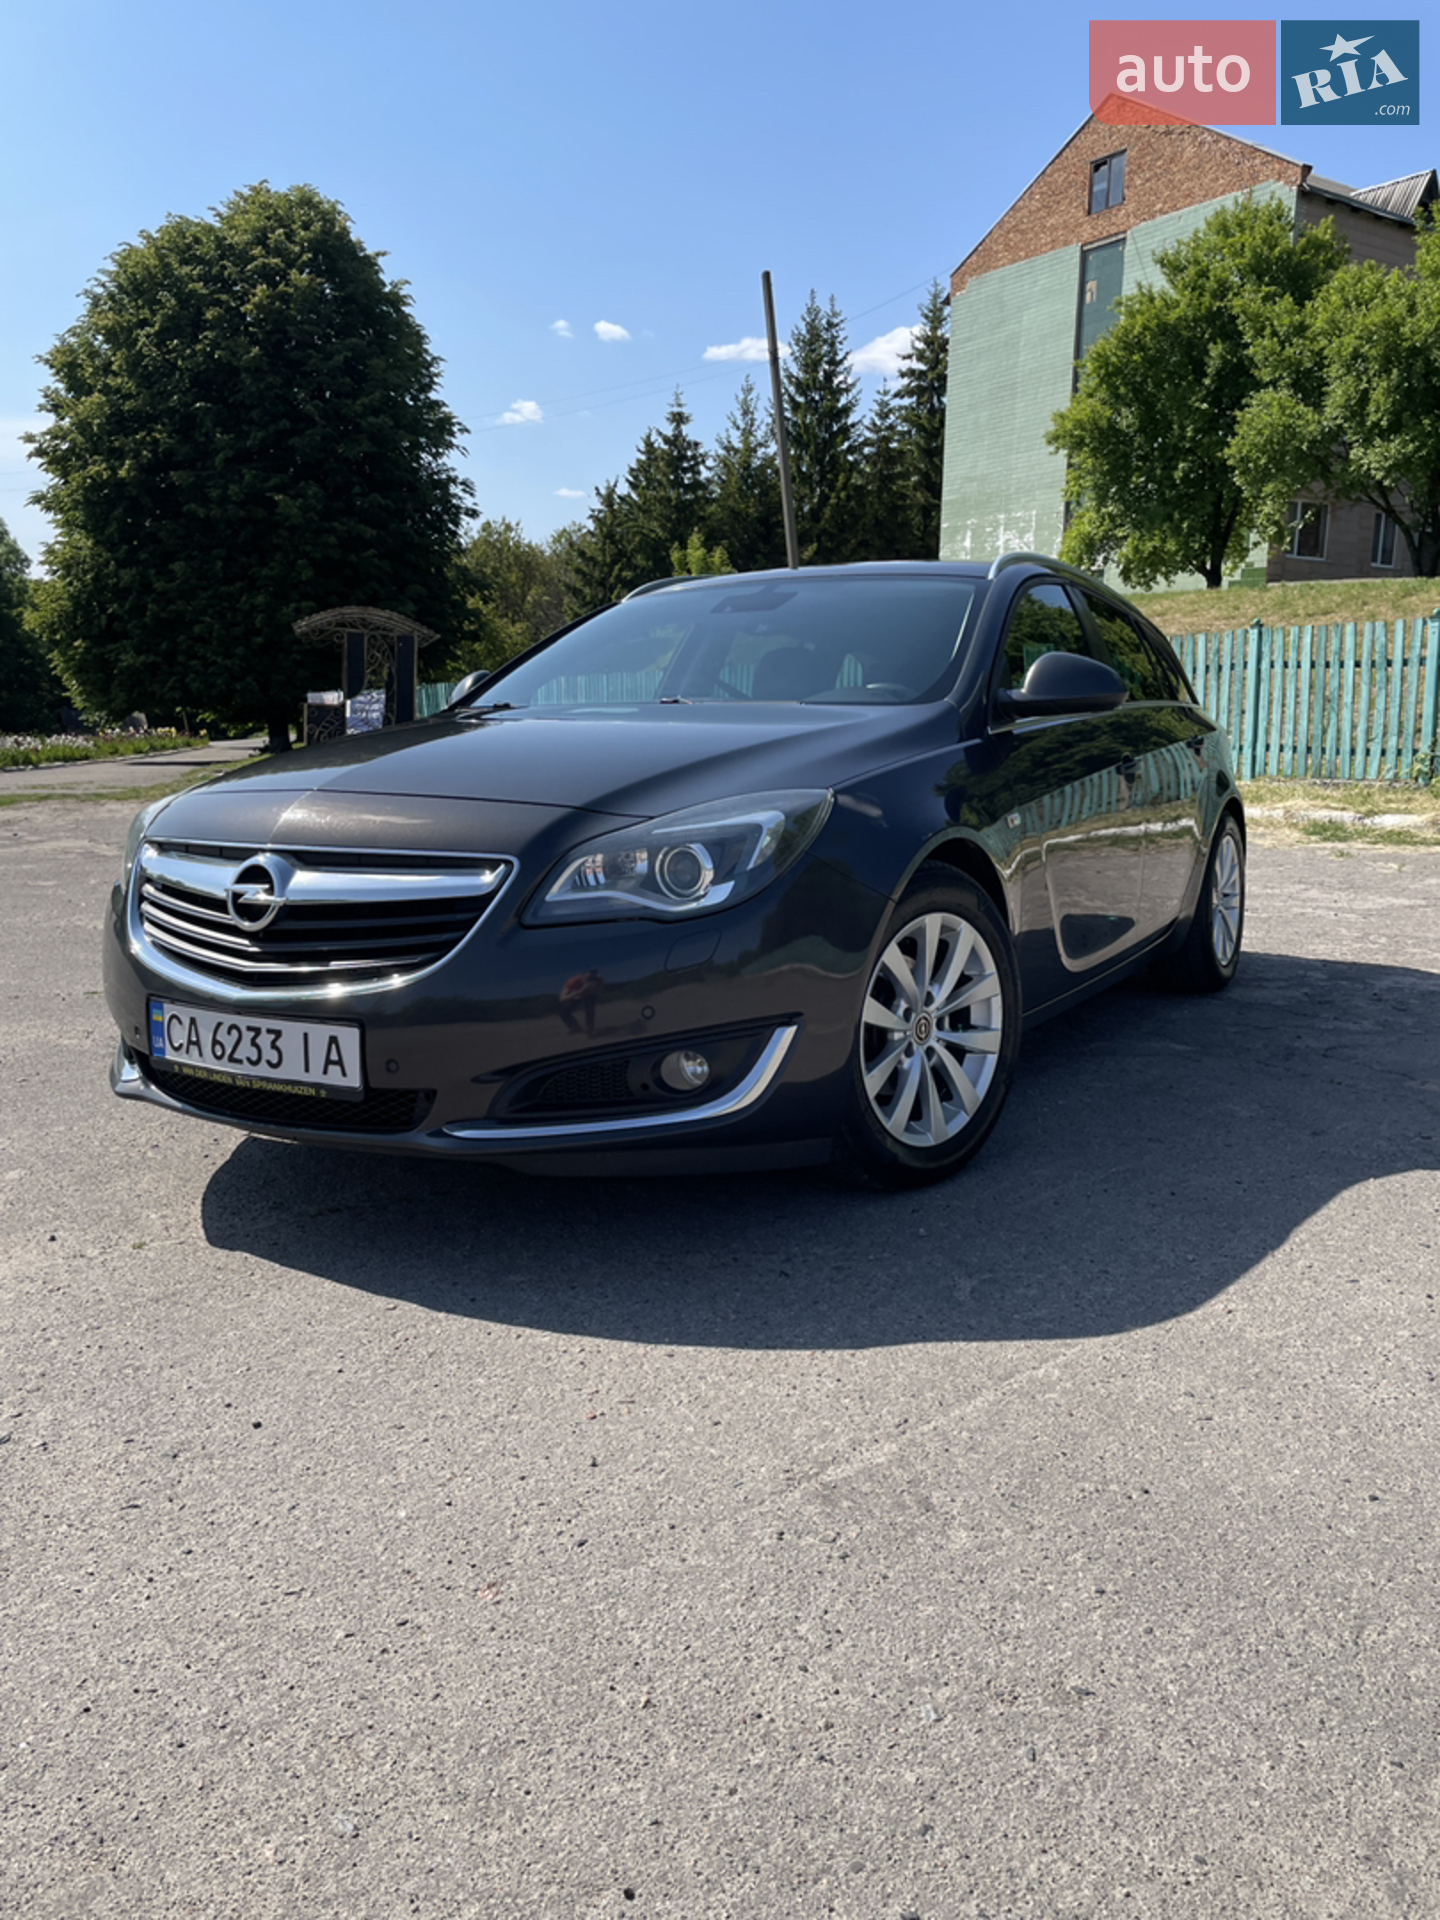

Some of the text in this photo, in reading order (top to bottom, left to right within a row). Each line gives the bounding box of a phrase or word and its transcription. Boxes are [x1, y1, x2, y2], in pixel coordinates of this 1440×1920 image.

[167, 1013, 347, 1078] CA 6233 IA
